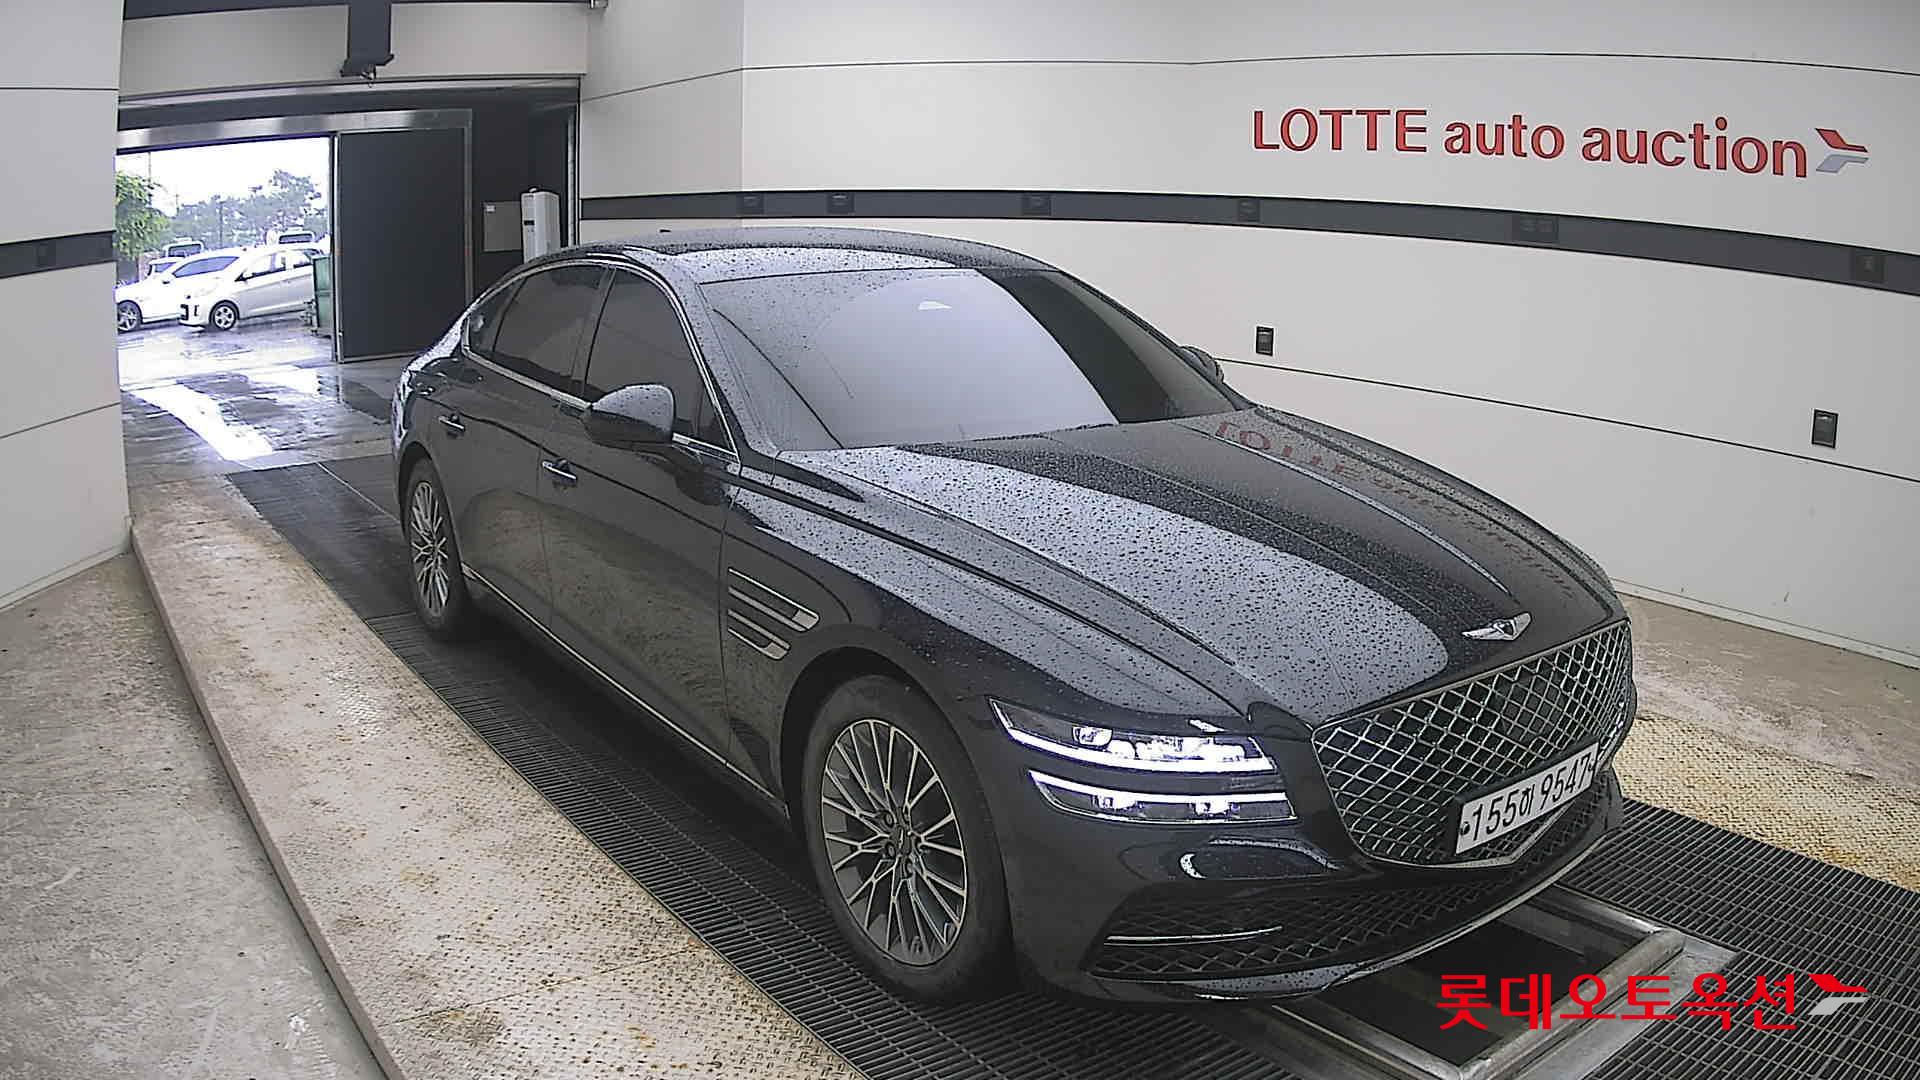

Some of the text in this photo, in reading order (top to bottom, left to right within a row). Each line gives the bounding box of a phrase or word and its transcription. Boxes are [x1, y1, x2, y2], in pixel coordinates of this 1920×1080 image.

[1253, 108, 1809, 179] LOTTE auto auction
[1540, 753, 1593, 811] 9547
